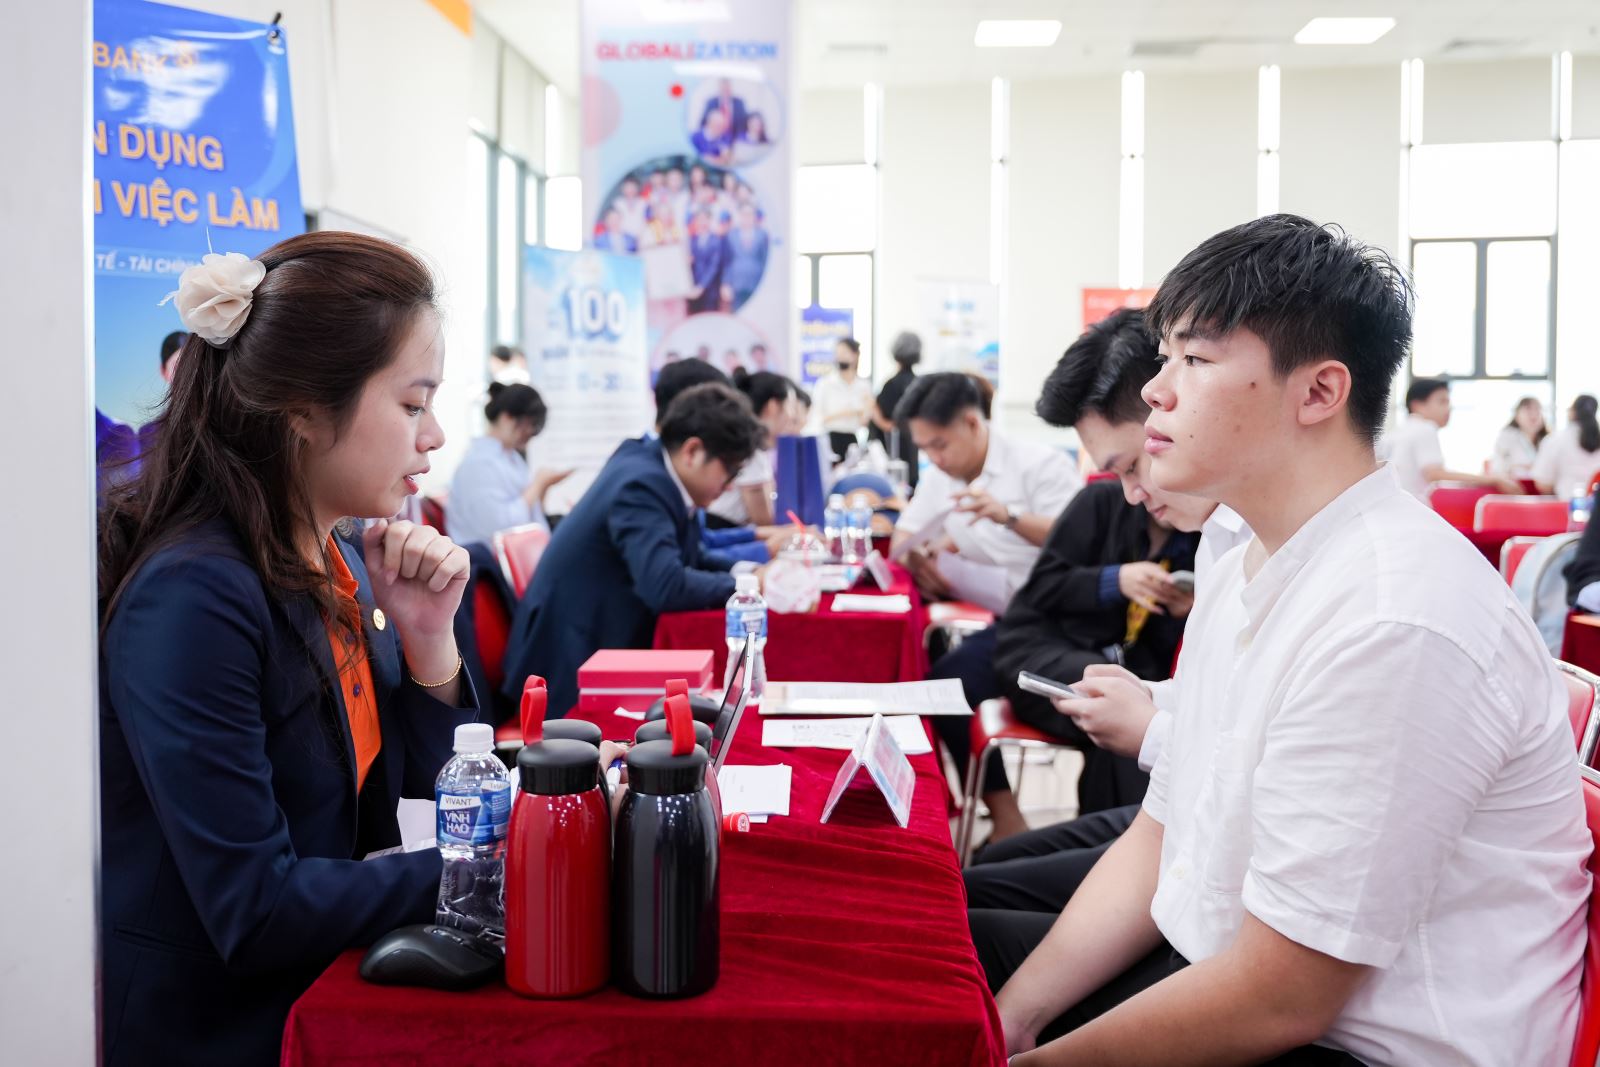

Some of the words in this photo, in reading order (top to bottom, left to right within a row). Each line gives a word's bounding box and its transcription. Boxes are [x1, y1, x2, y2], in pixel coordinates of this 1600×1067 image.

[596, 41, 778, 60] GLOBALIZATION
[119, 123, 224, 170] DỤNG
[111, 177, 199, 227] VIỆC
[207, 186, 279, 231] LÀM
[562, 285, 626, 341] 100
[445, 797, 472, 806] VIVANT
